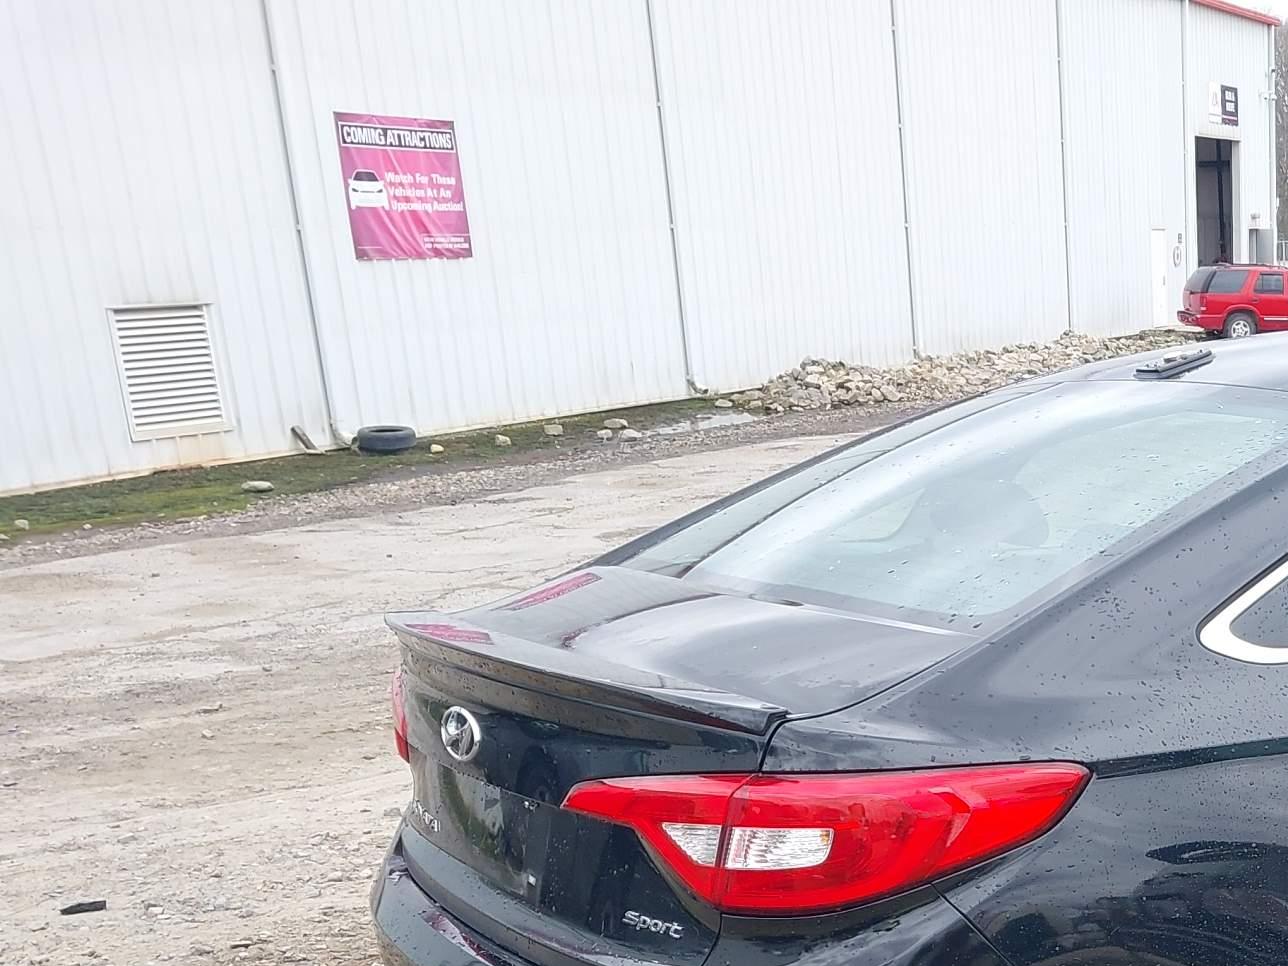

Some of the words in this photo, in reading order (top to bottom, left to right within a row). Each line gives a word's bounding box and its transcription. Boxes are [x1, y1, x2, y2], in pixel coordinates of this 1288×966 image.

[343, 125, 386, 145] COMING
[386, 130, 452, 149] ATTRACTIONS
[385, 172, 414, 184] Watch
[415, 172, 429, 185] For
[430, 173, 456, 185] These
[388, 185, 425, 198] Vehicles
[426, 187, 438, 198] At
[439, 187, 452, 198] An
[390, 199, 433, 213] Upcoming
[622, 909, 685, 940] Sport
